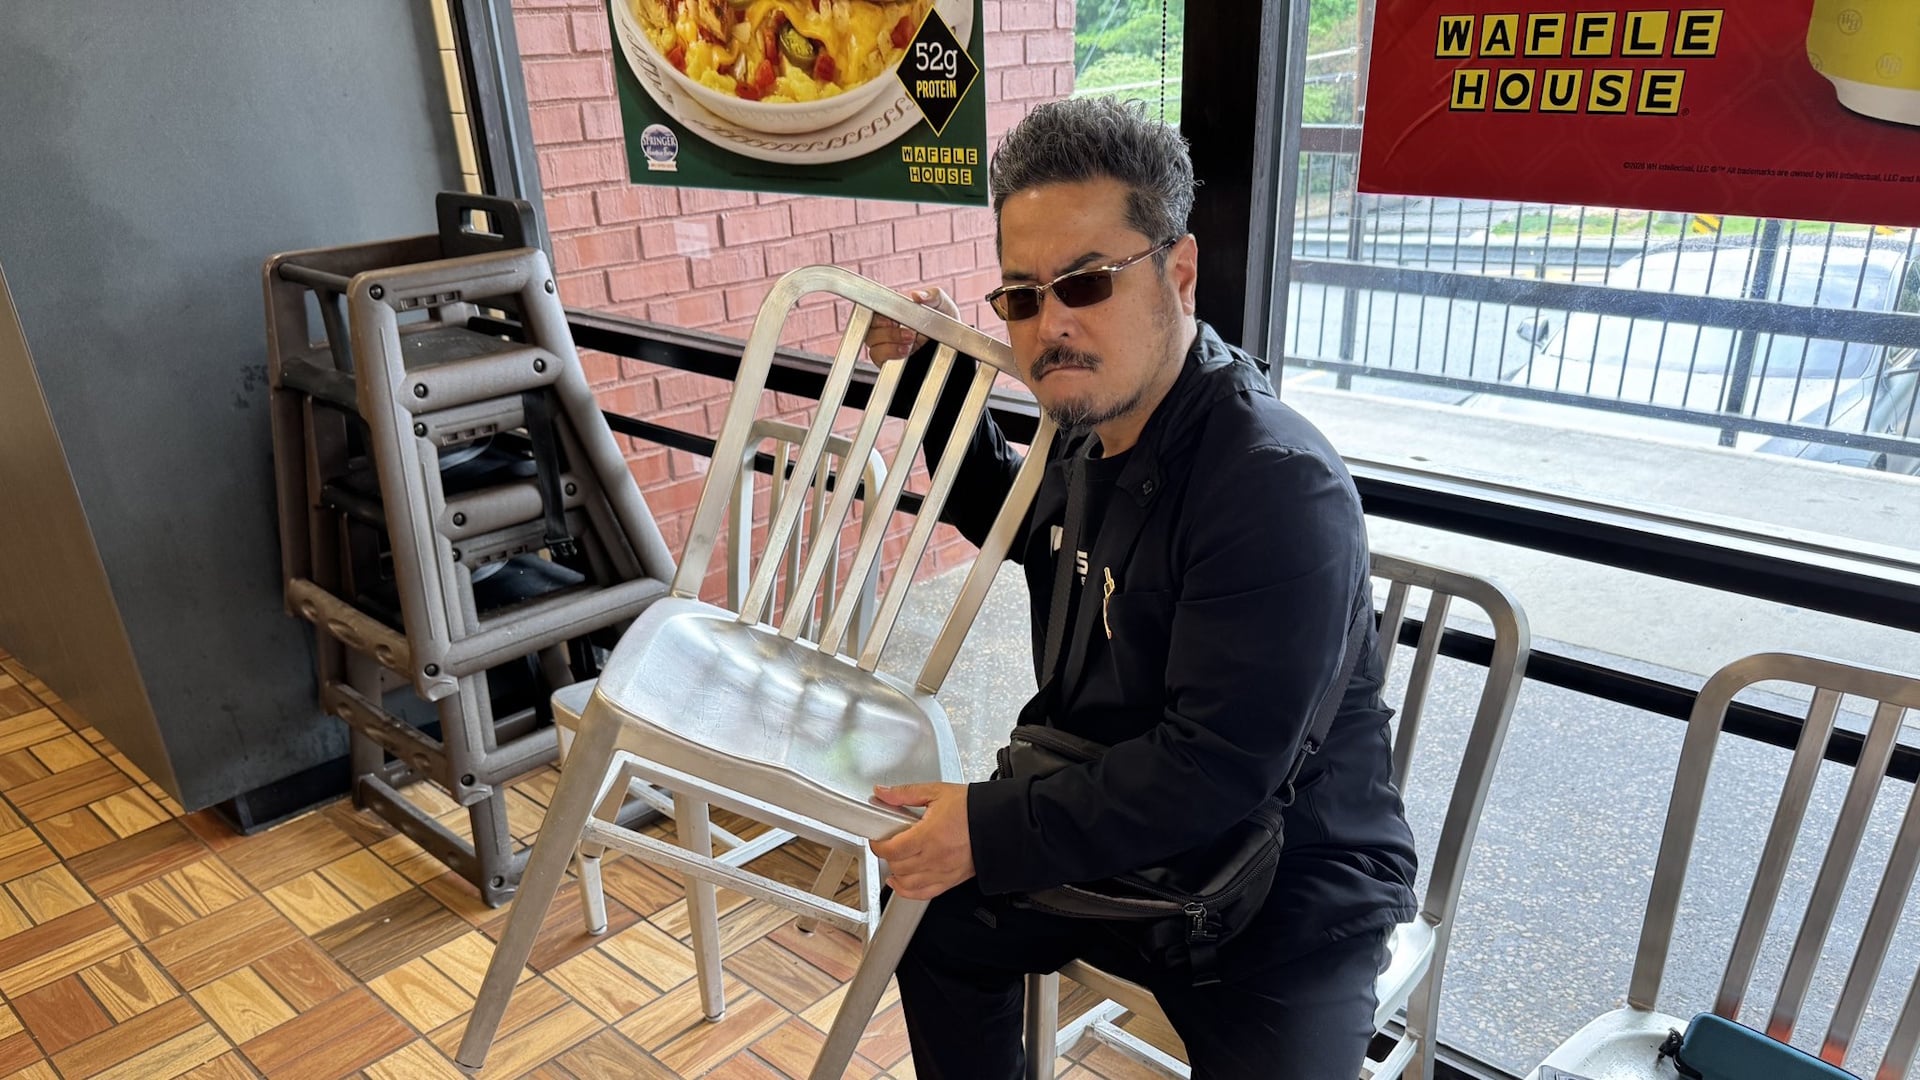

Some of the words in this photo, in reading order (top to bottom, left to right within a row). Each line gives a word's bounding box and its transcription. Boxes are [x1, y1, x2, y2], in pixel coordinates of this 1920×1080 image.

[1442, 15, 1714, 52] WAFFLE
[915, 41, 958, 79] 52g
[916, 79, 957, 98] PROTEIN
[1456, 73, 1677, 109] HOUSE
[902, 148, 976, 163] WAFFLE
[911, 168, 970, 183] HOUSE
